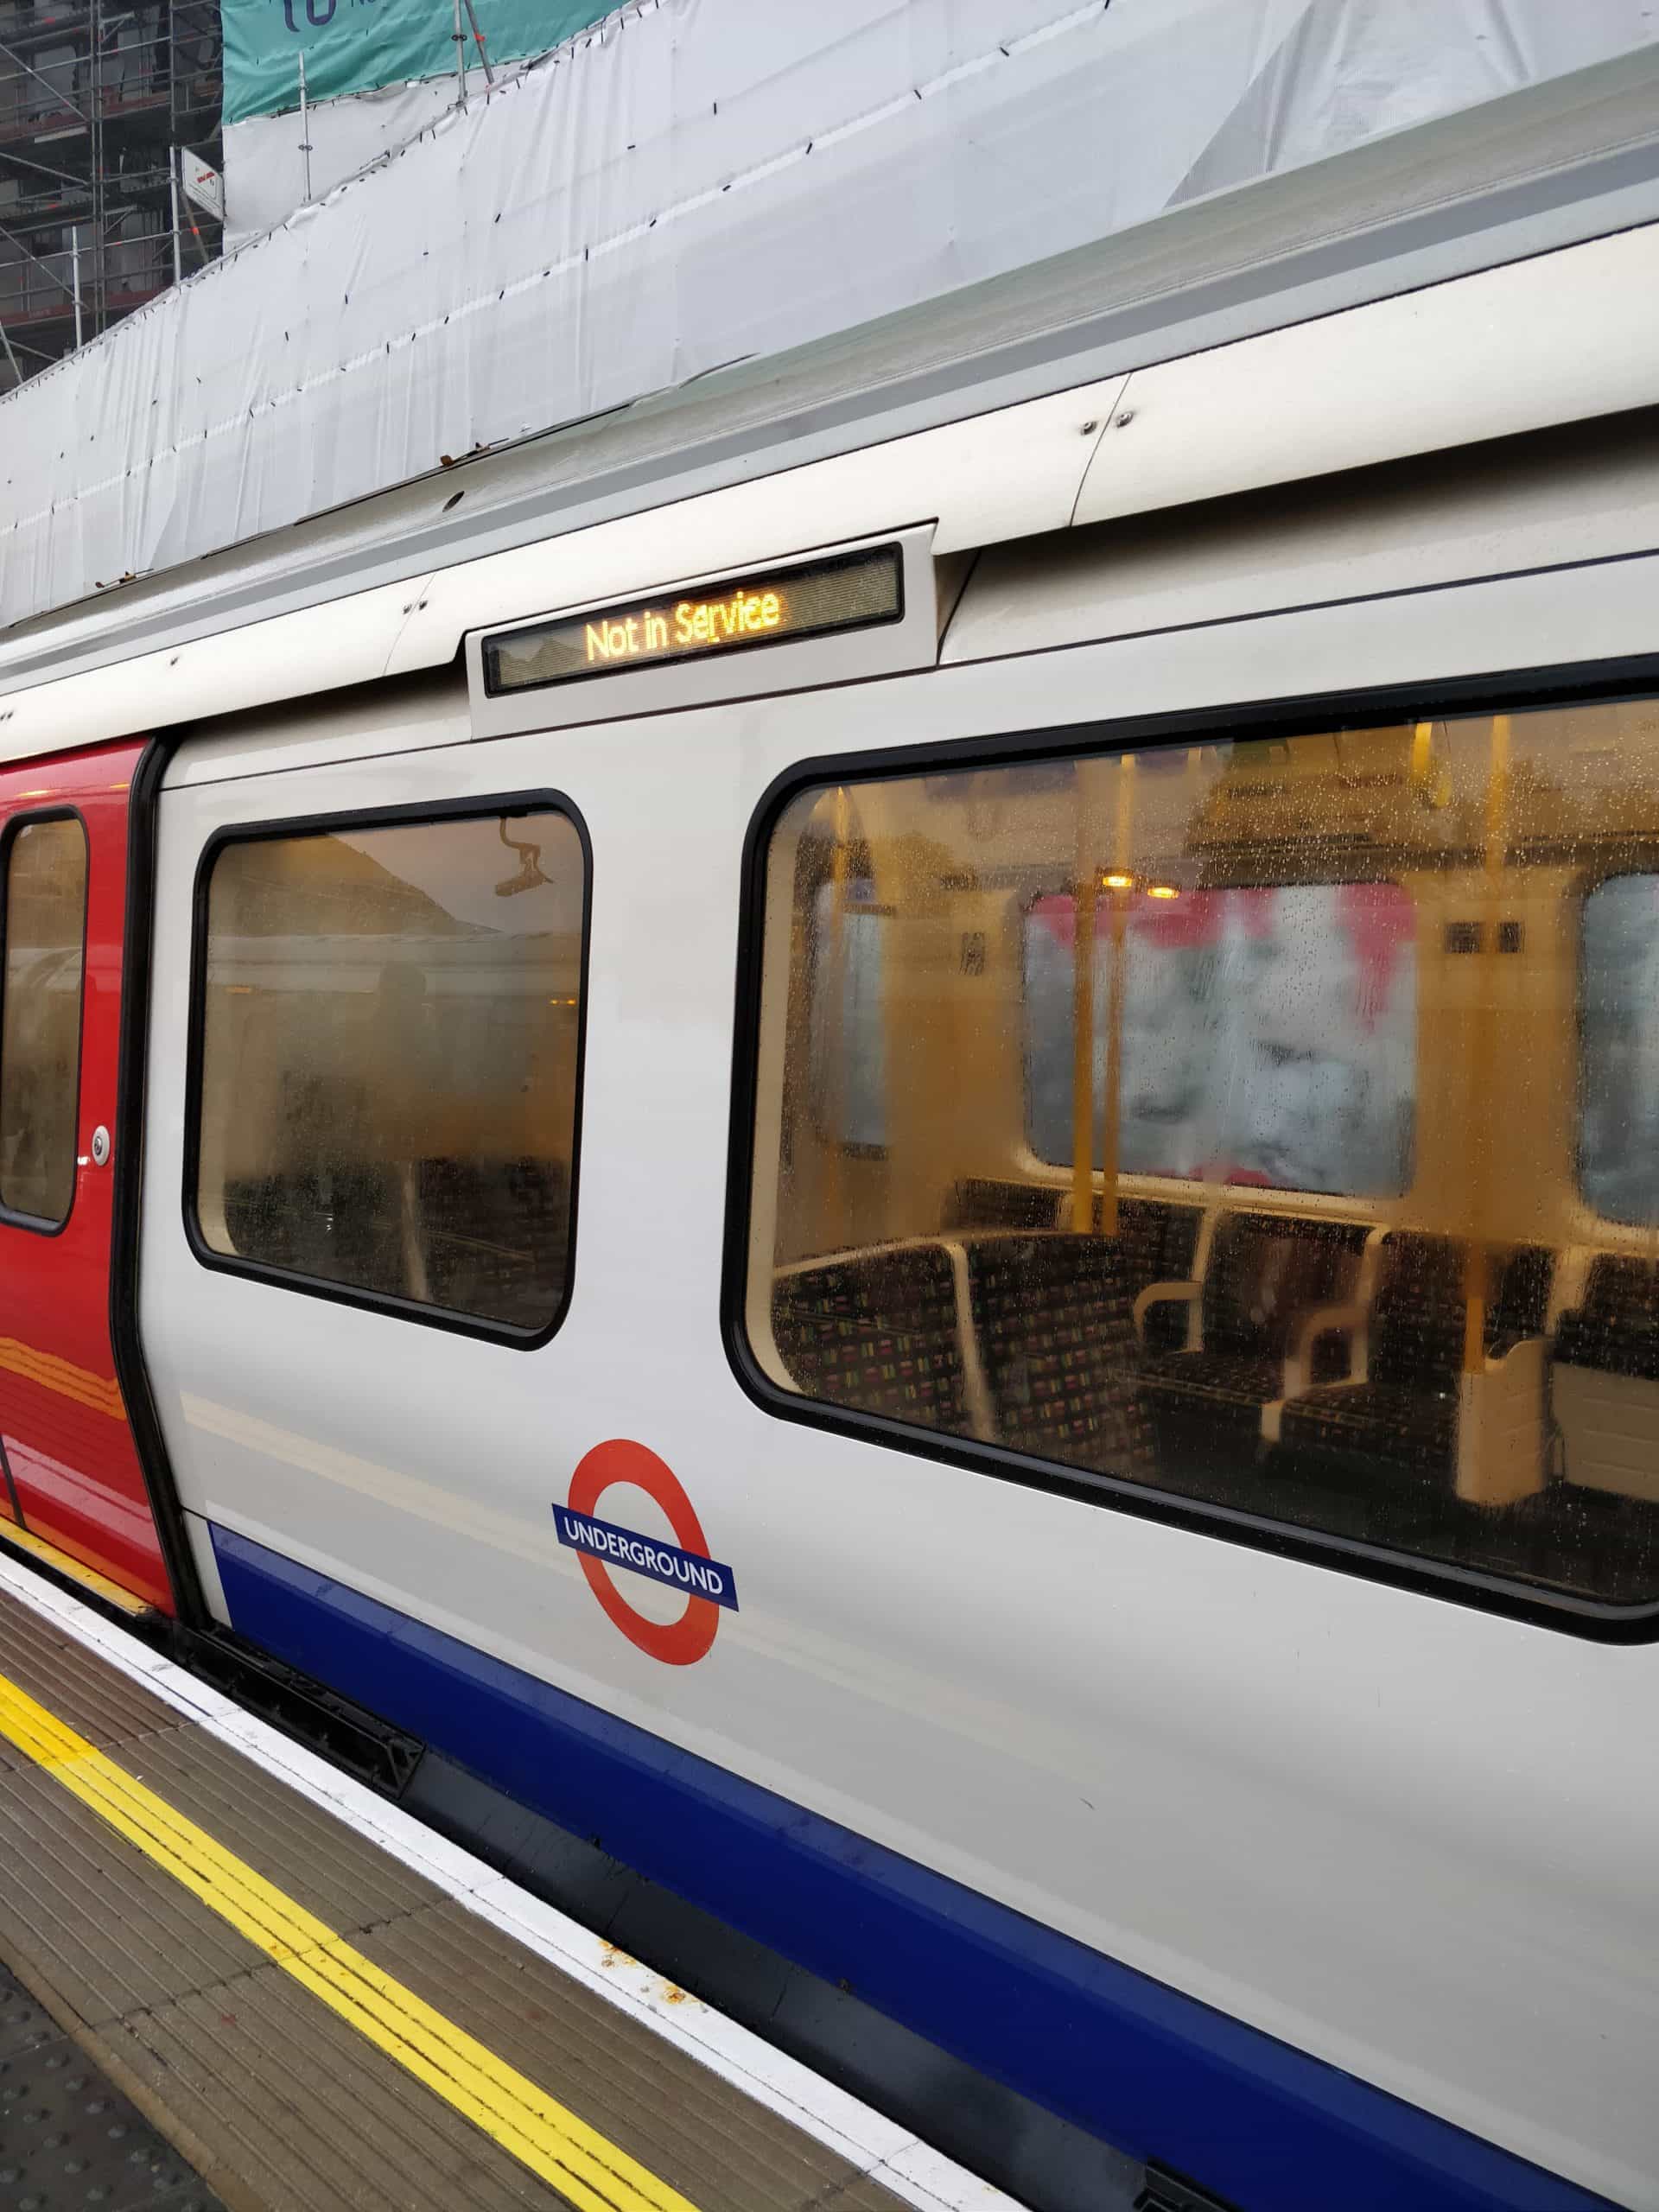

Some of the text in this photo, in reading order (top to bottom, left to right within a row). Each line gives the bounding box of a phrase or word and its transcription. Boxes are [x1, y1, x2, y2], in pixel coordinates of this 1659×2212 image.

[585, 591, 780, 661] Not in Service
[563, 1516, 723, 1594] UNDERGROUND
